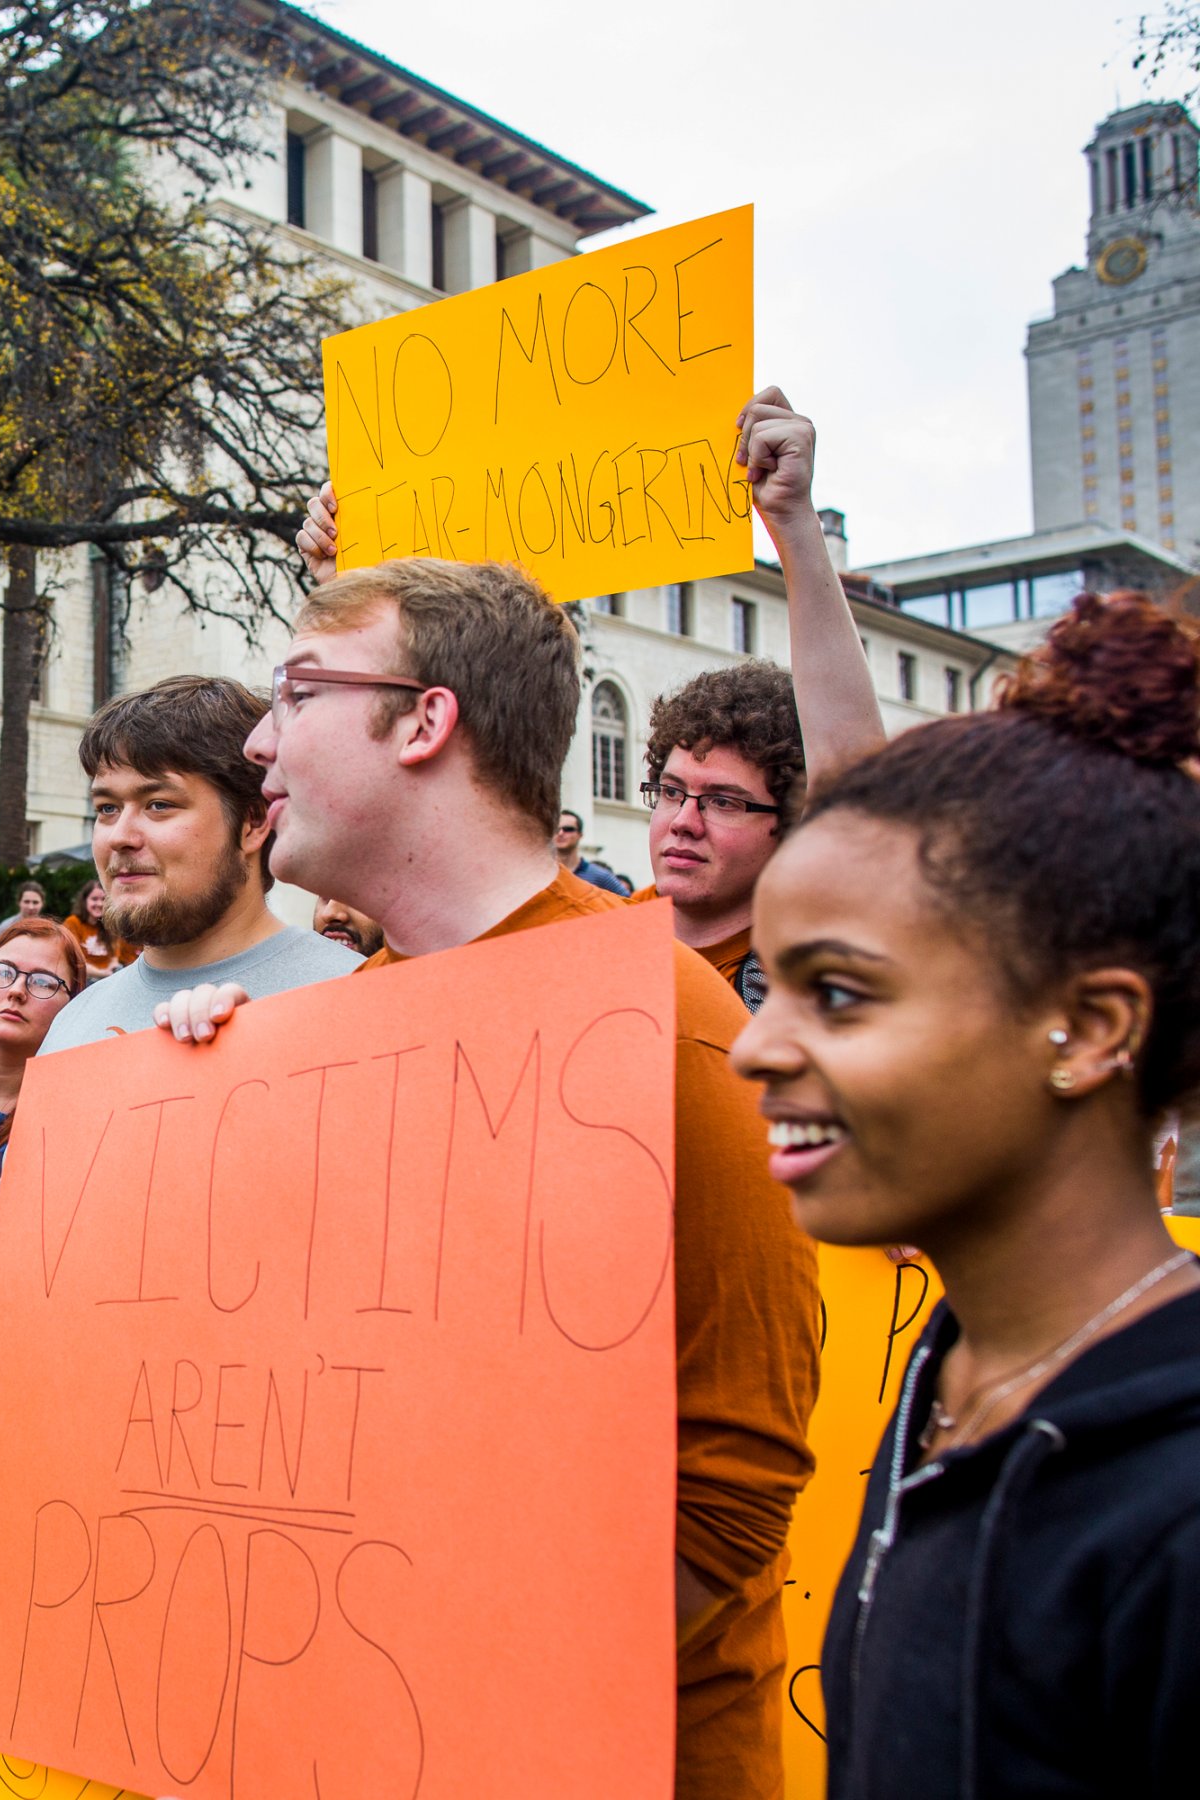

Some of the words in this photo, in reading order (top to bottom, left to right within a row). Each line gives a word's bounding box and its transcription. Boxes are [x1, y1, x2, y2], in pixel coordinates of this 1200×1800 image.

[336, 333, 453, 484] NO
[494, 237, 733, 425] MORE
[41, 1007, 675, 1351] VICTIMS
[115, 1352, 385, 1501] AREN'T
[9, 1498, 426, 1800] PROPS
